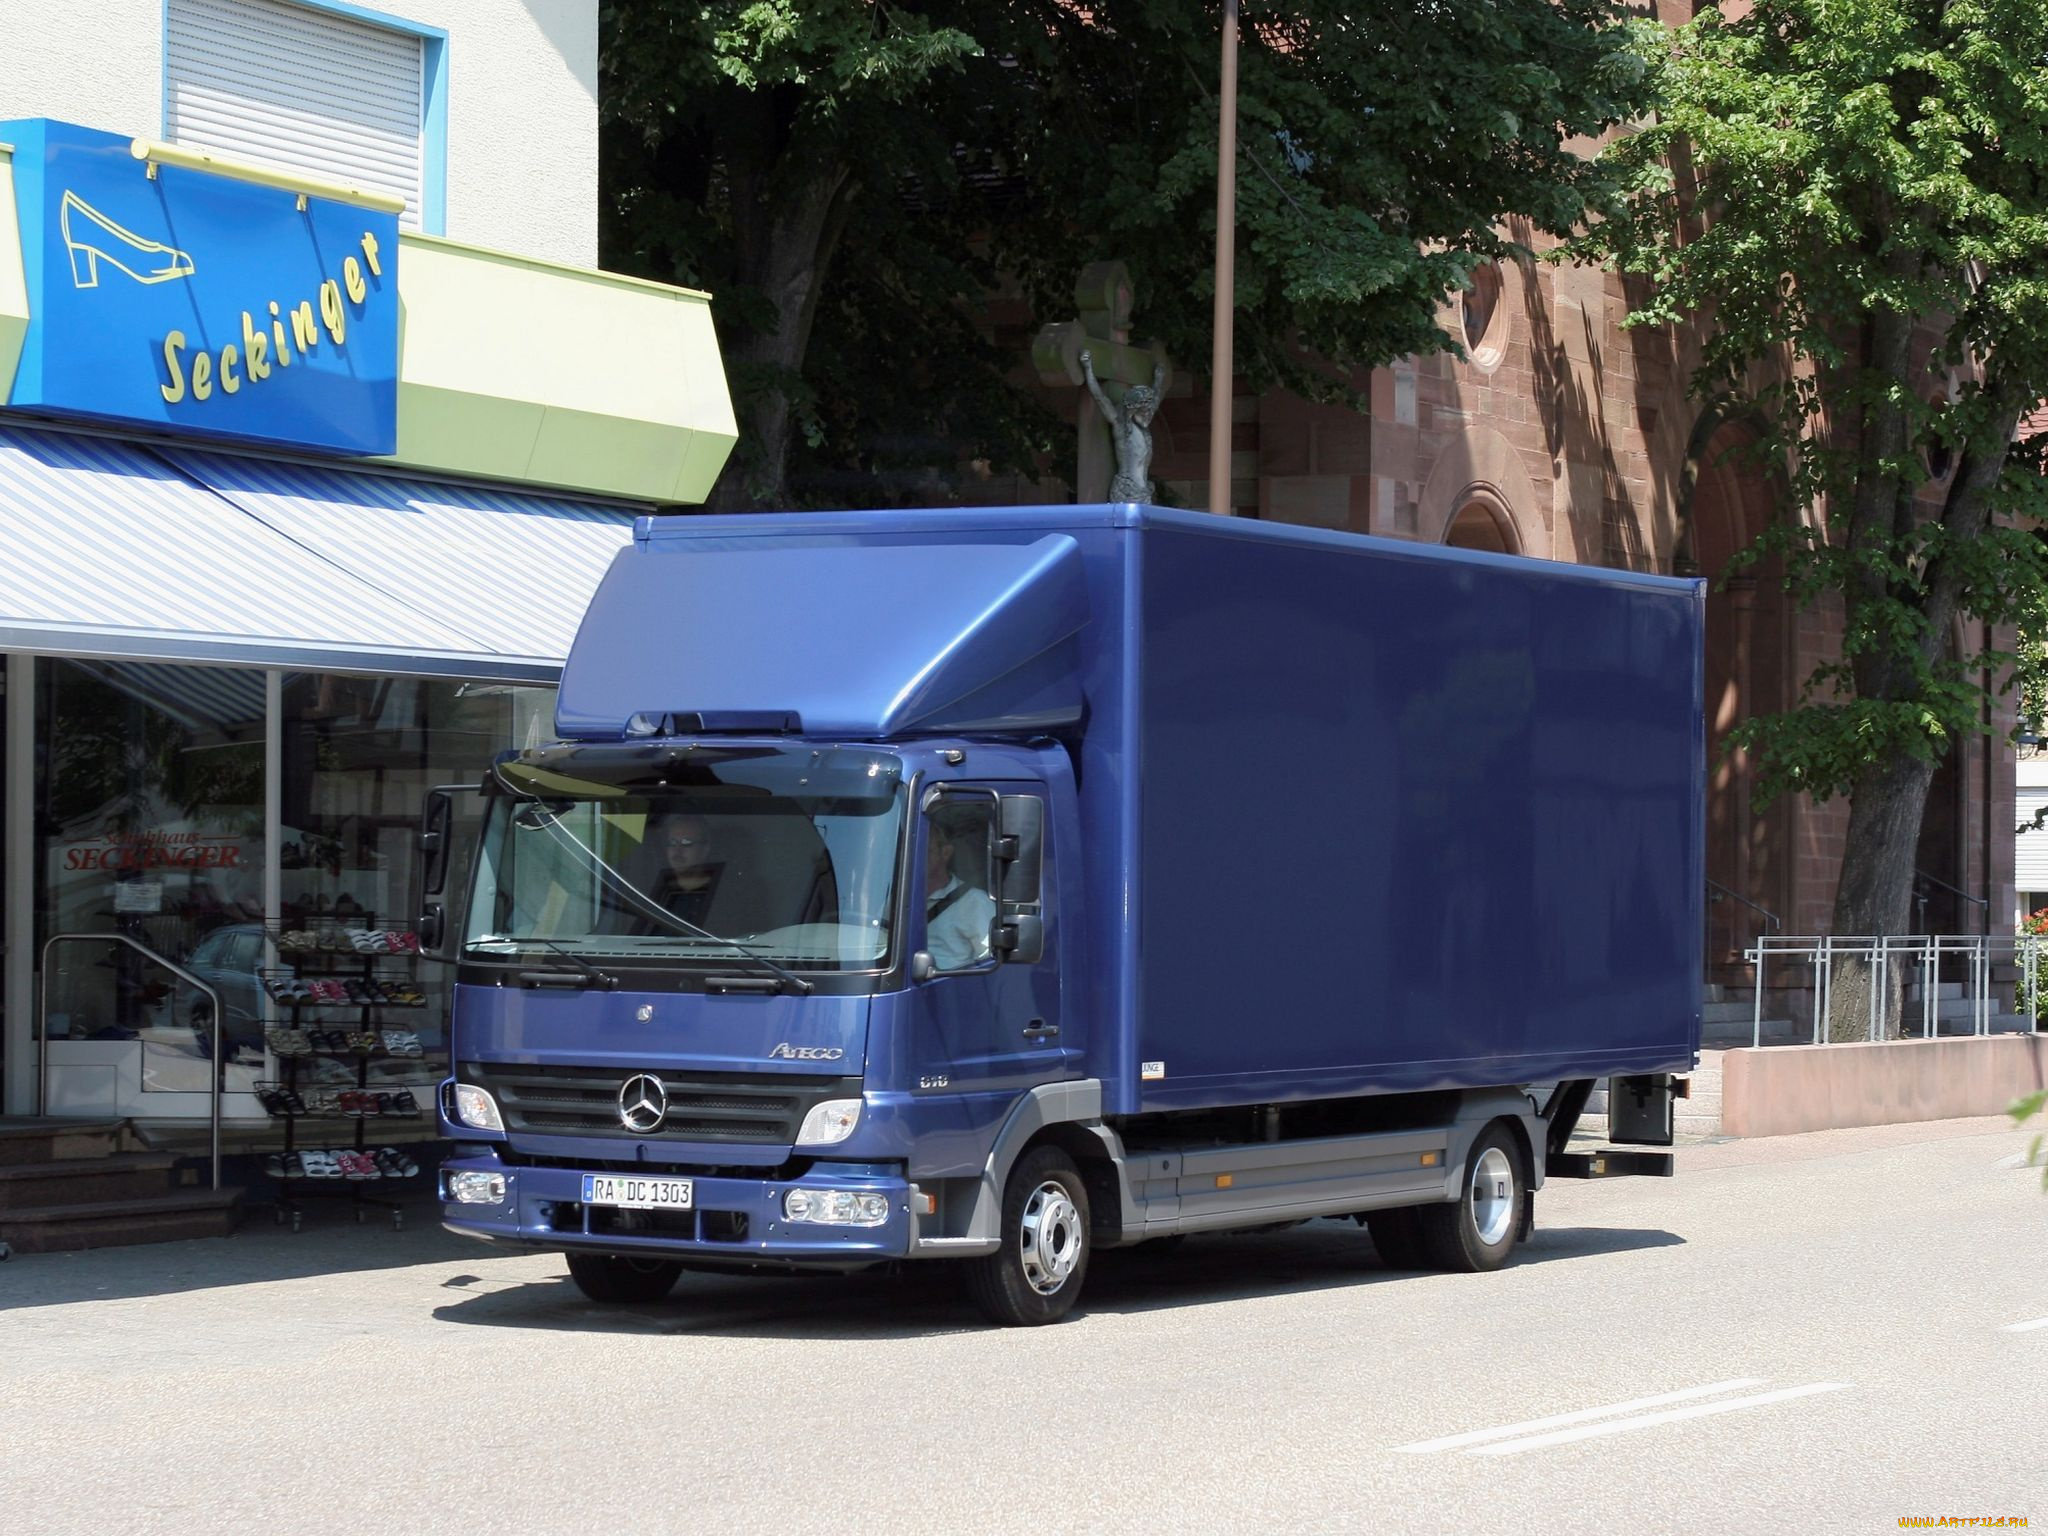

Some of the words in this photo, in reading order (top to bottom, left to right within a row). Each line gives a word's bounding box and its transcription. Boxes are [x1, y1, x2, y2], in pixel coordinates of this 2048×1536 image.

[161, 232, 381, 403] Seckinger
[64, 846, 240, 870] SECKINGER
[595, 1180, 614, 1200] RA
[627, 1182, 646, 1201] DC
[651, 1183, 690, 1203] 1303
